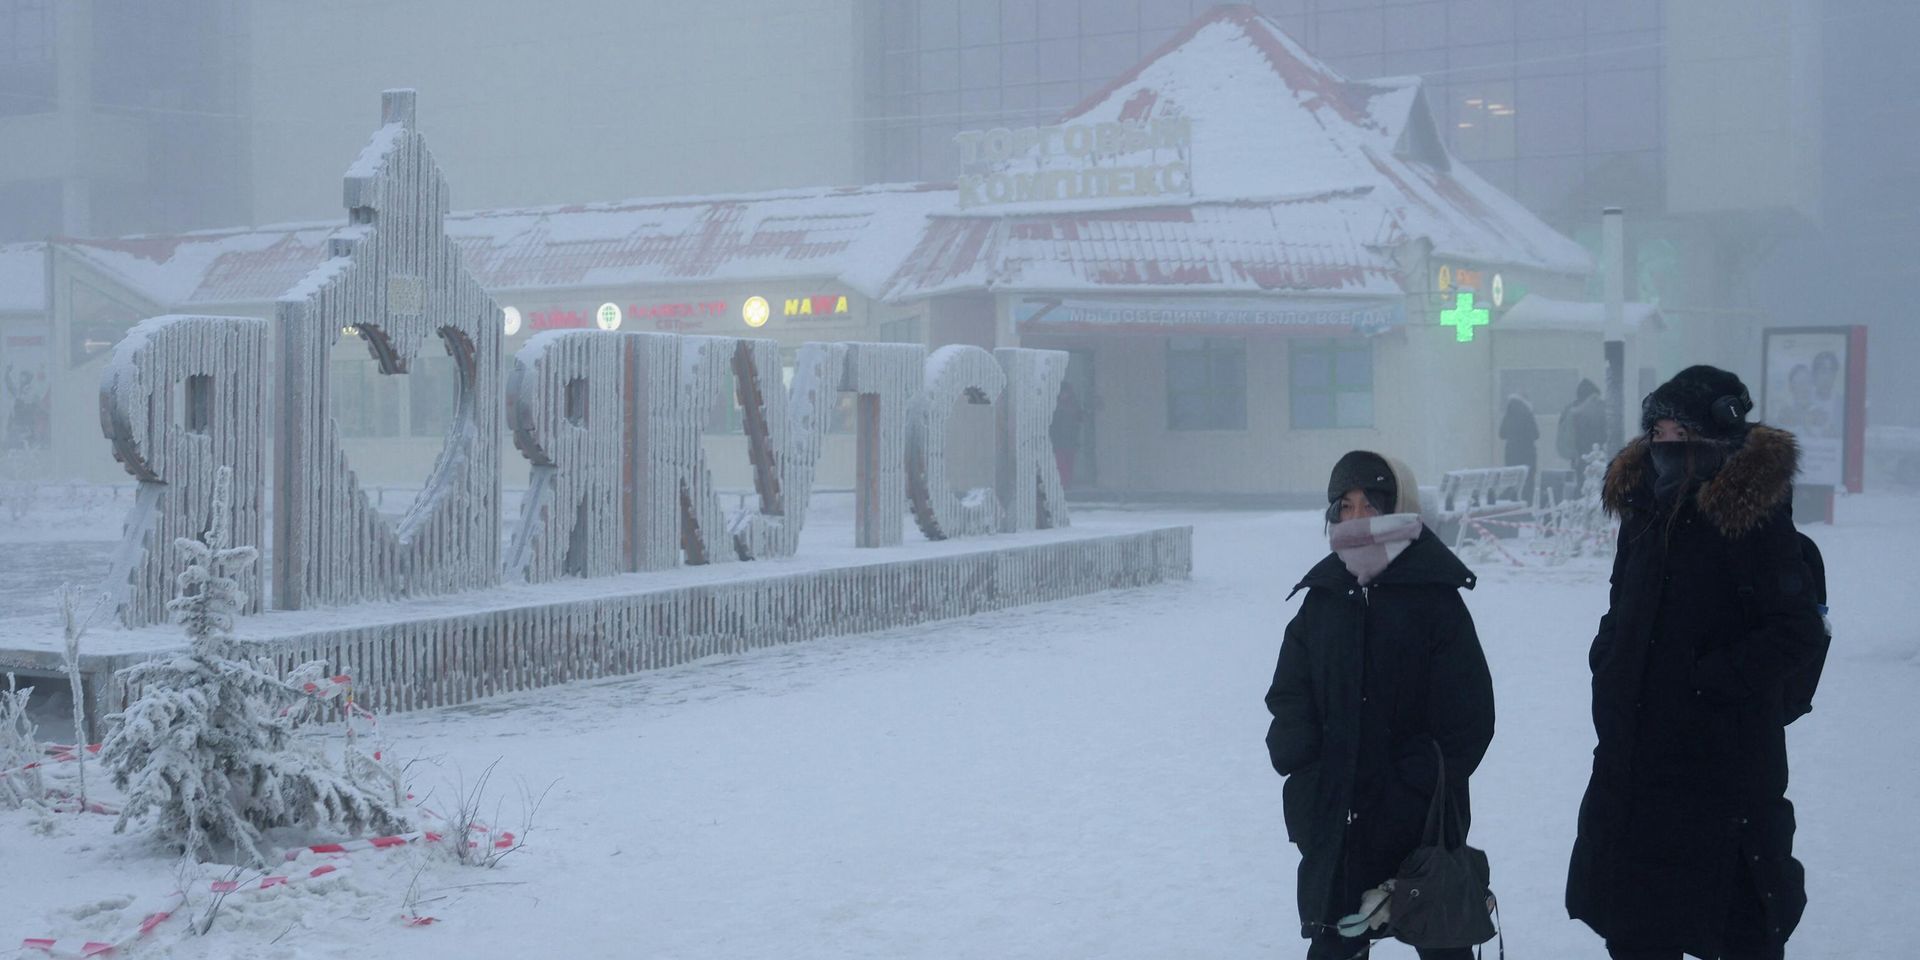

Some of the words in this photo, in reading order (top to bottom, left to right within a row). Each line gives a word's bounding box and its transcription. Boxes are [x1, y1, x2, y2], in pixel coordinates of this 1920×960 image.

[958, 160, 1191, 208] КОМПЛЕКС
[1215, 311, 1249, 325] ТАК
[1255, 311, 1310, 325] БЫЛО
[1315, 311, 1393, 326] ВСЕГДА!
